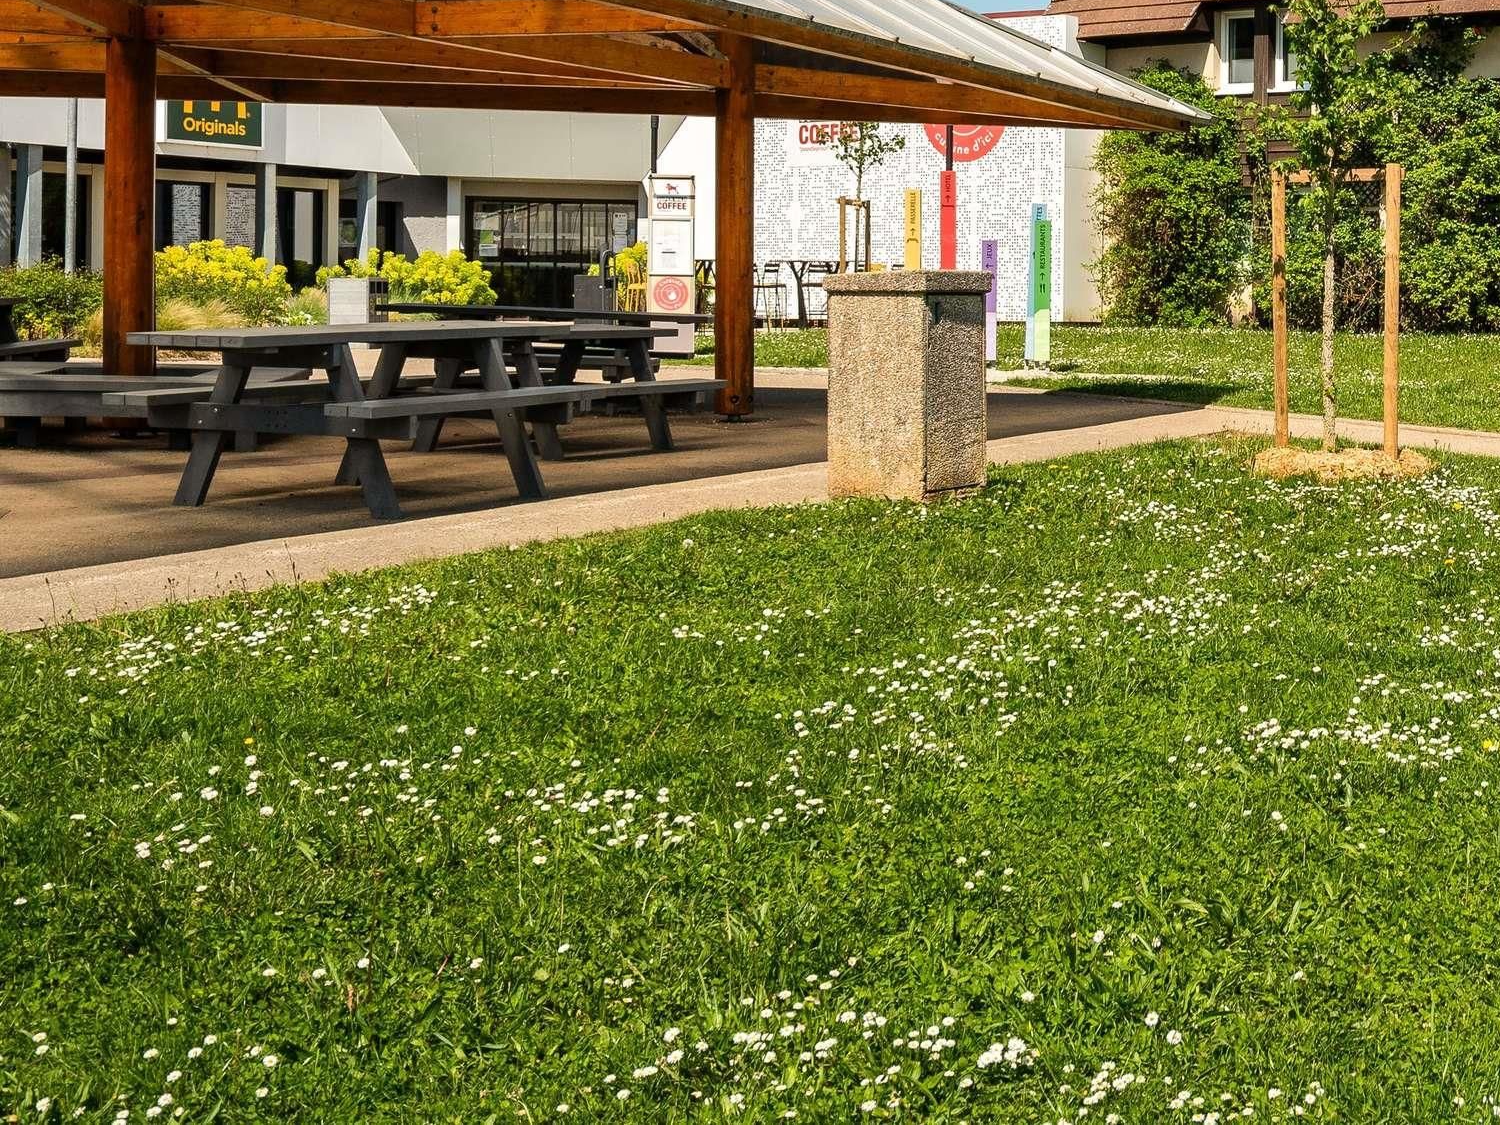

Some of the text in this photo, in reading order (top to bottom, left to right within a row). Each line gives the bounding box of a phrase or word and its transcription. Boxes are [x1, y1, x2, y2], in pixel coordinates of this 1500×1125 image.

[183, 117, 246, 136] Originals
[656, 202, 687, 210] COFFEE
[1039, 224, 1047, 270] RESTAURANTS
